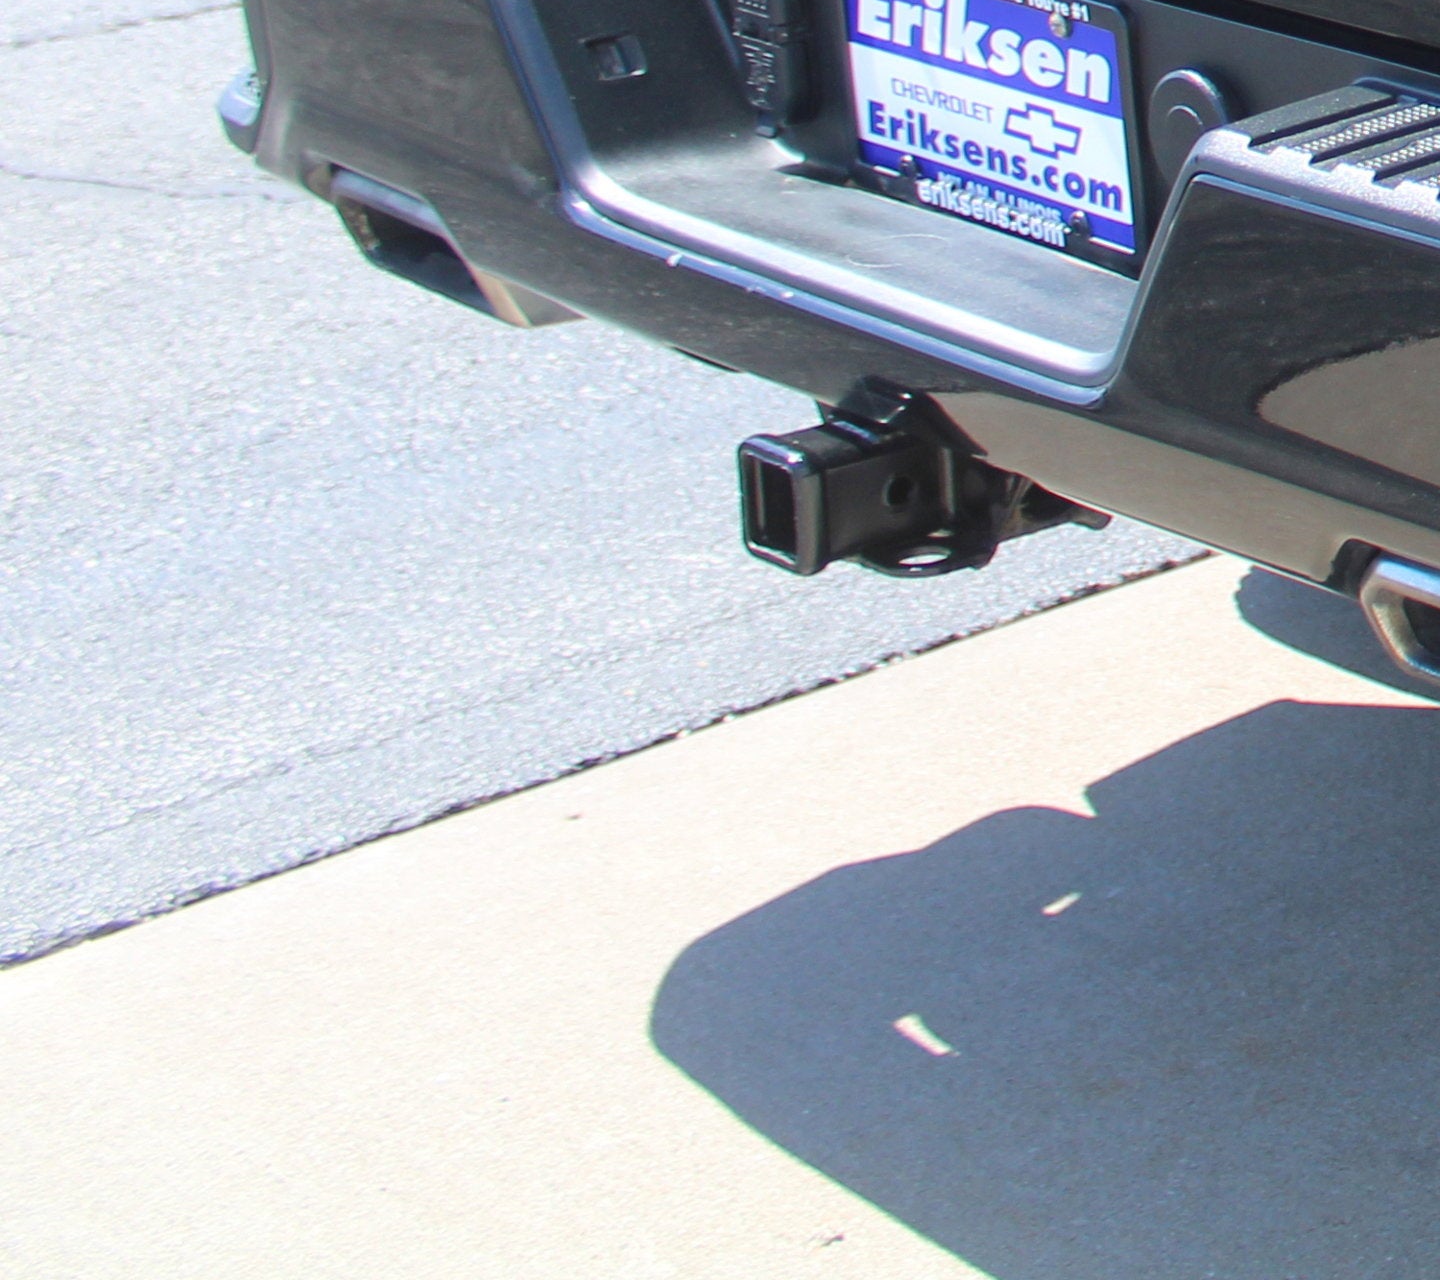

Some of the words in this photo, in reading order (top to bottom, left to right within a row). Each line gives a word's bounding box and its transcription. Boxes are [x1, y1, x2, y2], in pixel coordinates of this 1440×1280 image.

[1071, 3, 1091, 22] #1
[891, 77, 994, 125] CHEVROLET
[867, 100, 1123, 213] Eriksens.com
[916, 179, 1066, 249] eriksens.com
